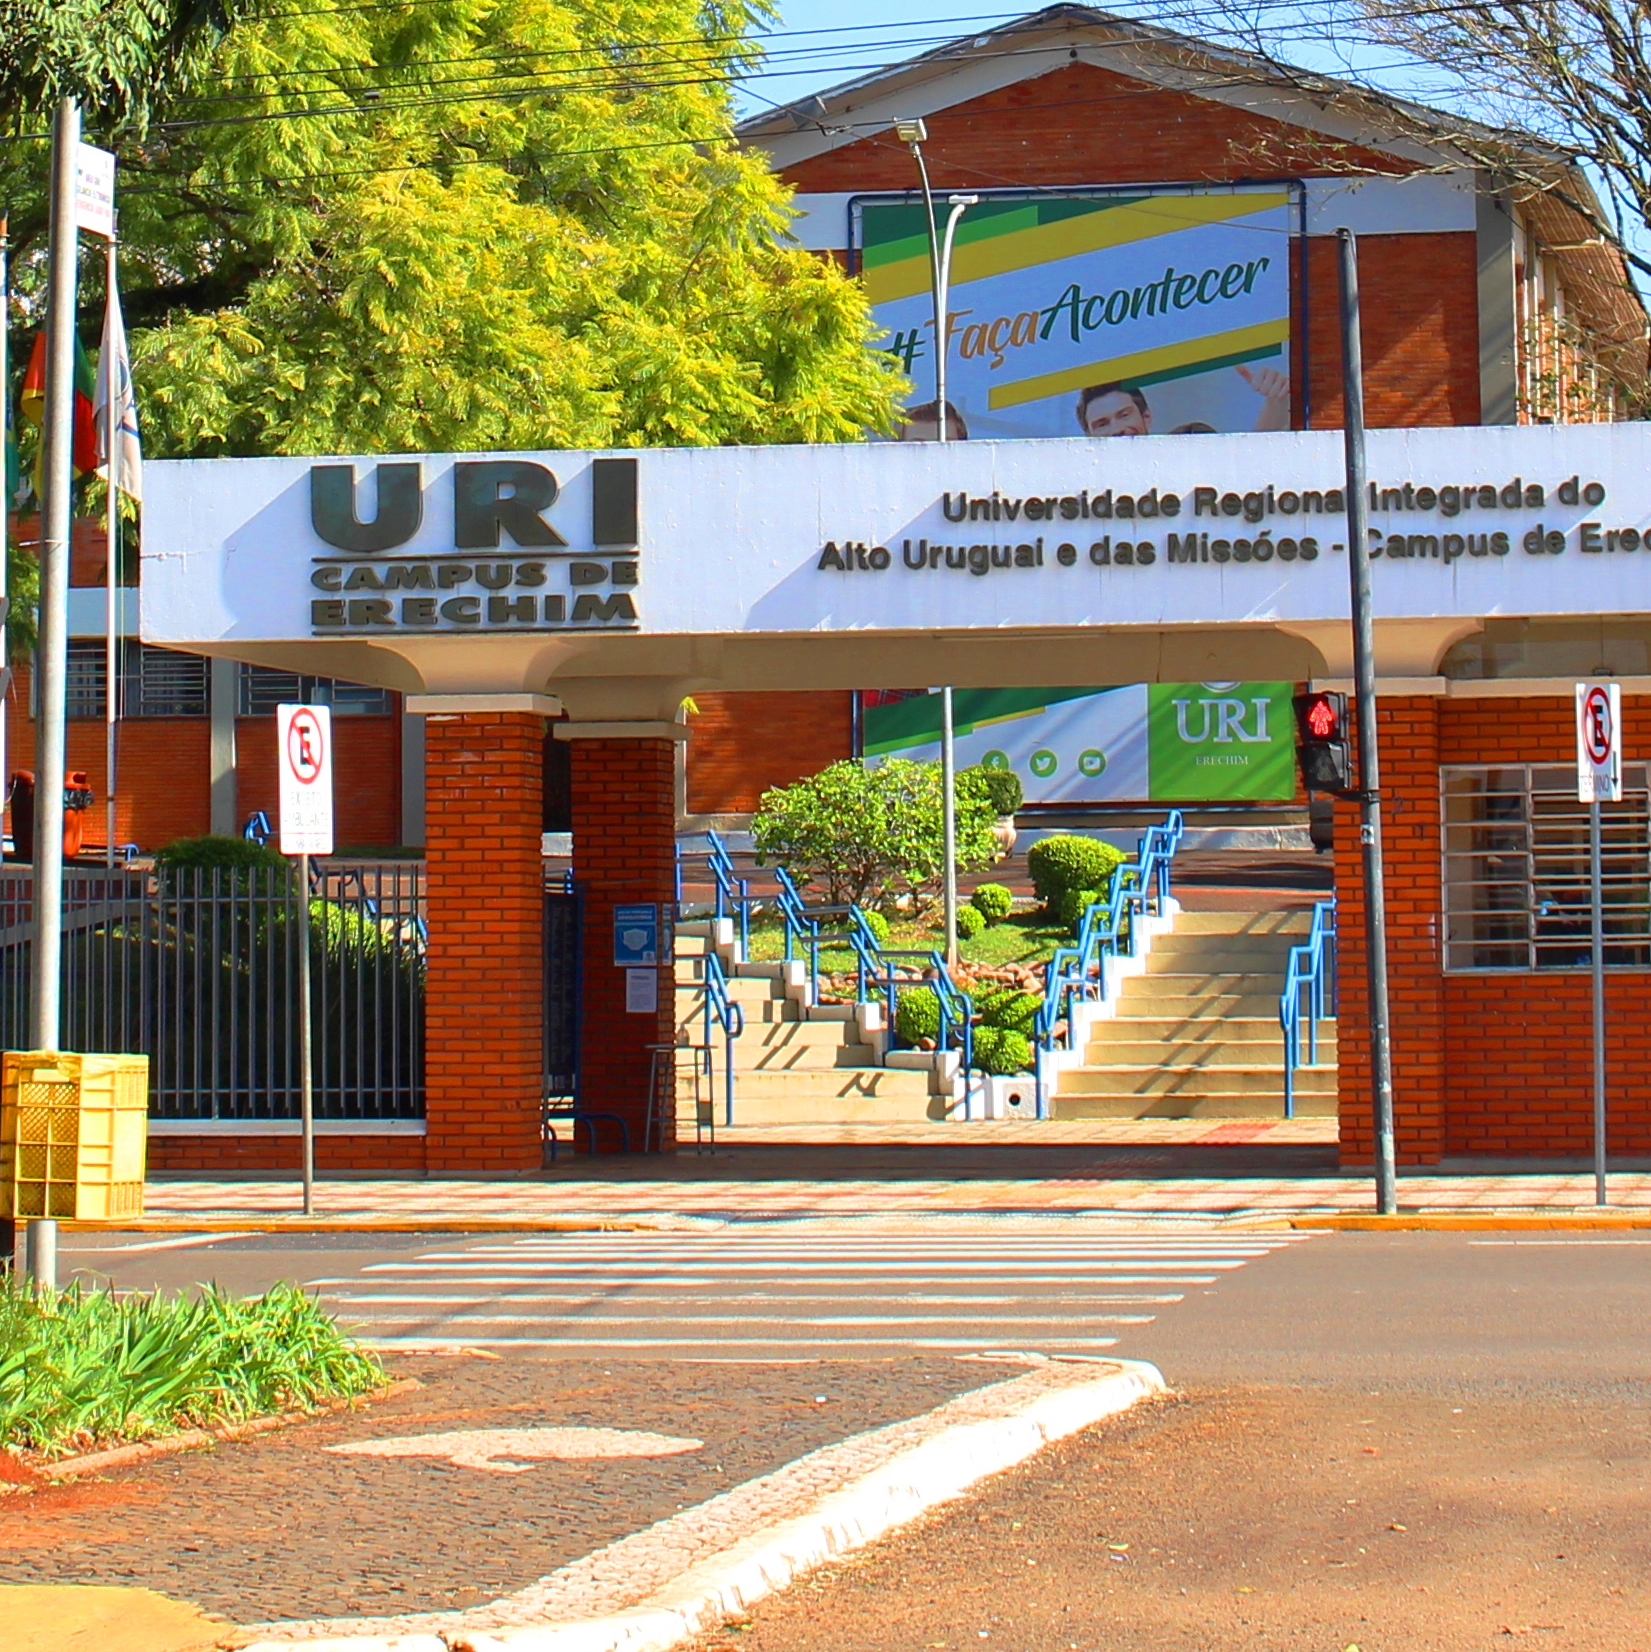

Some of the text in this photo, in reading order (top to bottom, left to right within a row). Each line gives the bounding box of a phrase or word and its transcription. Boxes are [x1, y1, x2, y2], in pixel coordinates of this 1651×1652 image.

[310, 458, 640, 551] URI
[942, 475, 1606, 523] Universidade Regiona Integrada do
[817, 541, 891, 572] Alto
[902, 537, 1044, 576] Uruguai
[1056, 543, 1077, 568] e
[1089, 534, 1157, 568] das
[1523, 523, 1566, 556] de
[310, 559, 640, 592] CAMPUS DE
[310, 594, 637, 628] ERECHIM
[1171, 697, 1272, 743] URI
[1195, 755, 1249, 765] ERECHIM
